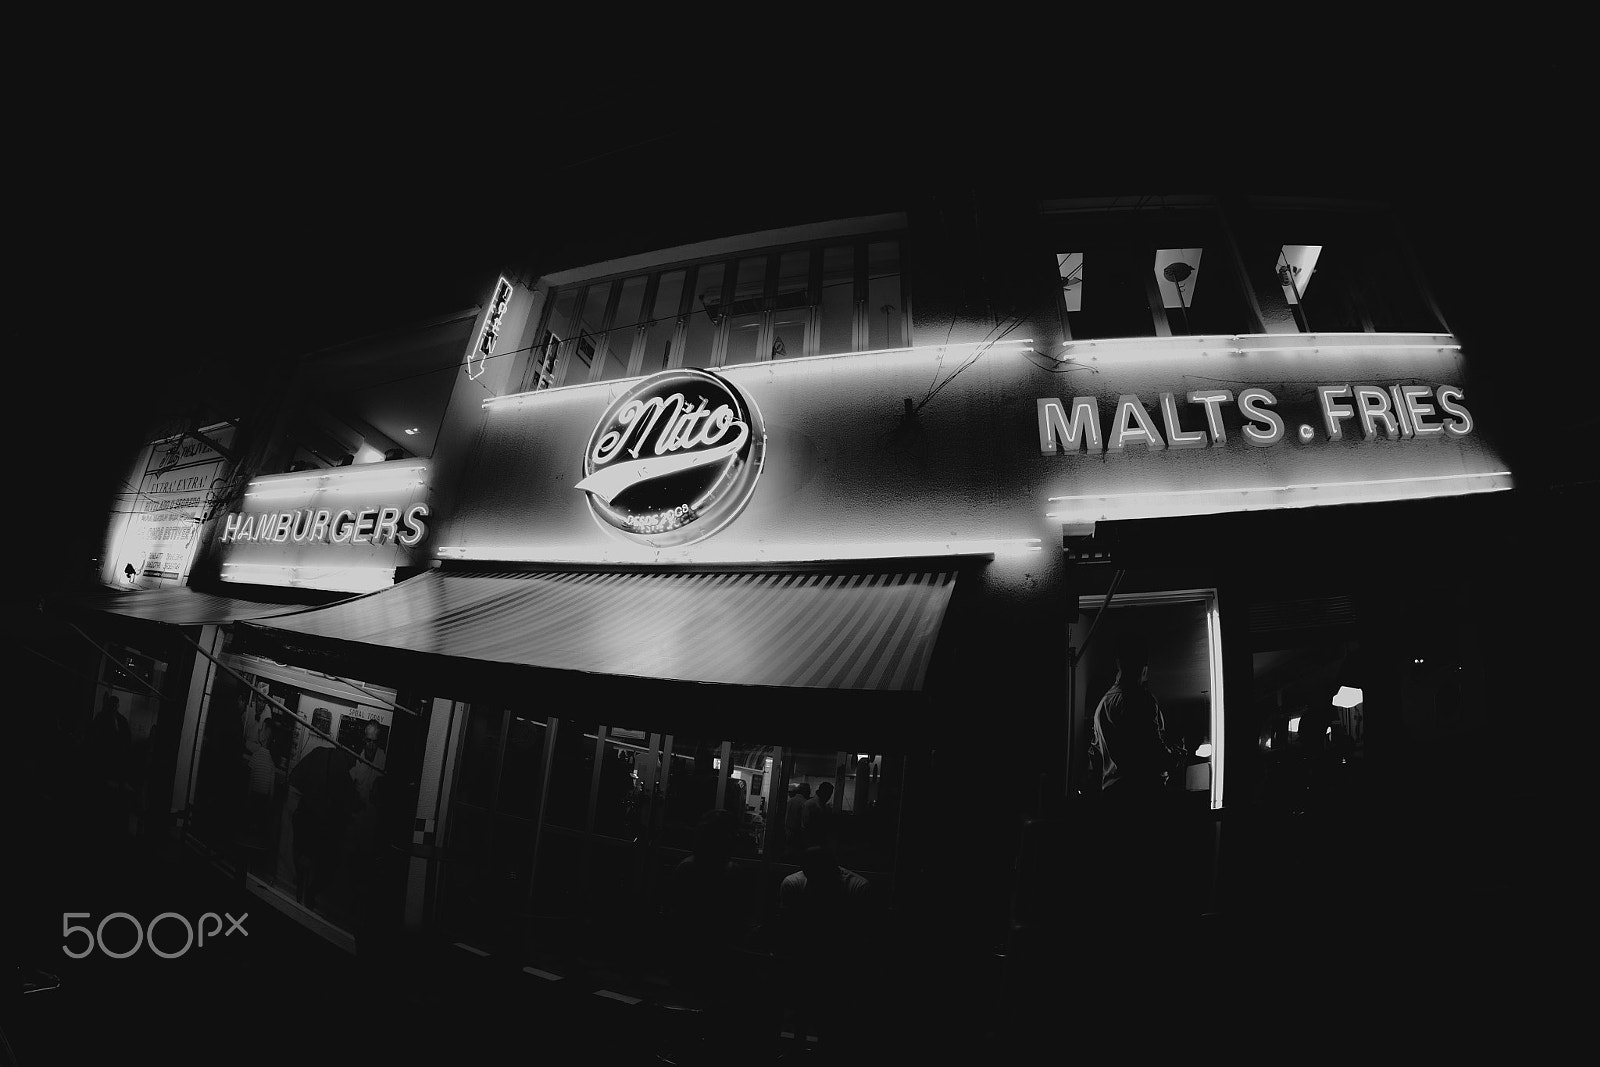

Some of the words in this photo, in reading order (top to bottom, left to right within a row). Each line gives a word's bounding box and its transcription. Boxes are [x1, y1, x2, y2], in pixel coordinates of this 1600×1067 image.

[592, 393, 745, 465] Mito
[1317, 383, 1475, 442] FRIES
[221, 503, 430, 546] HAMBURGERS
